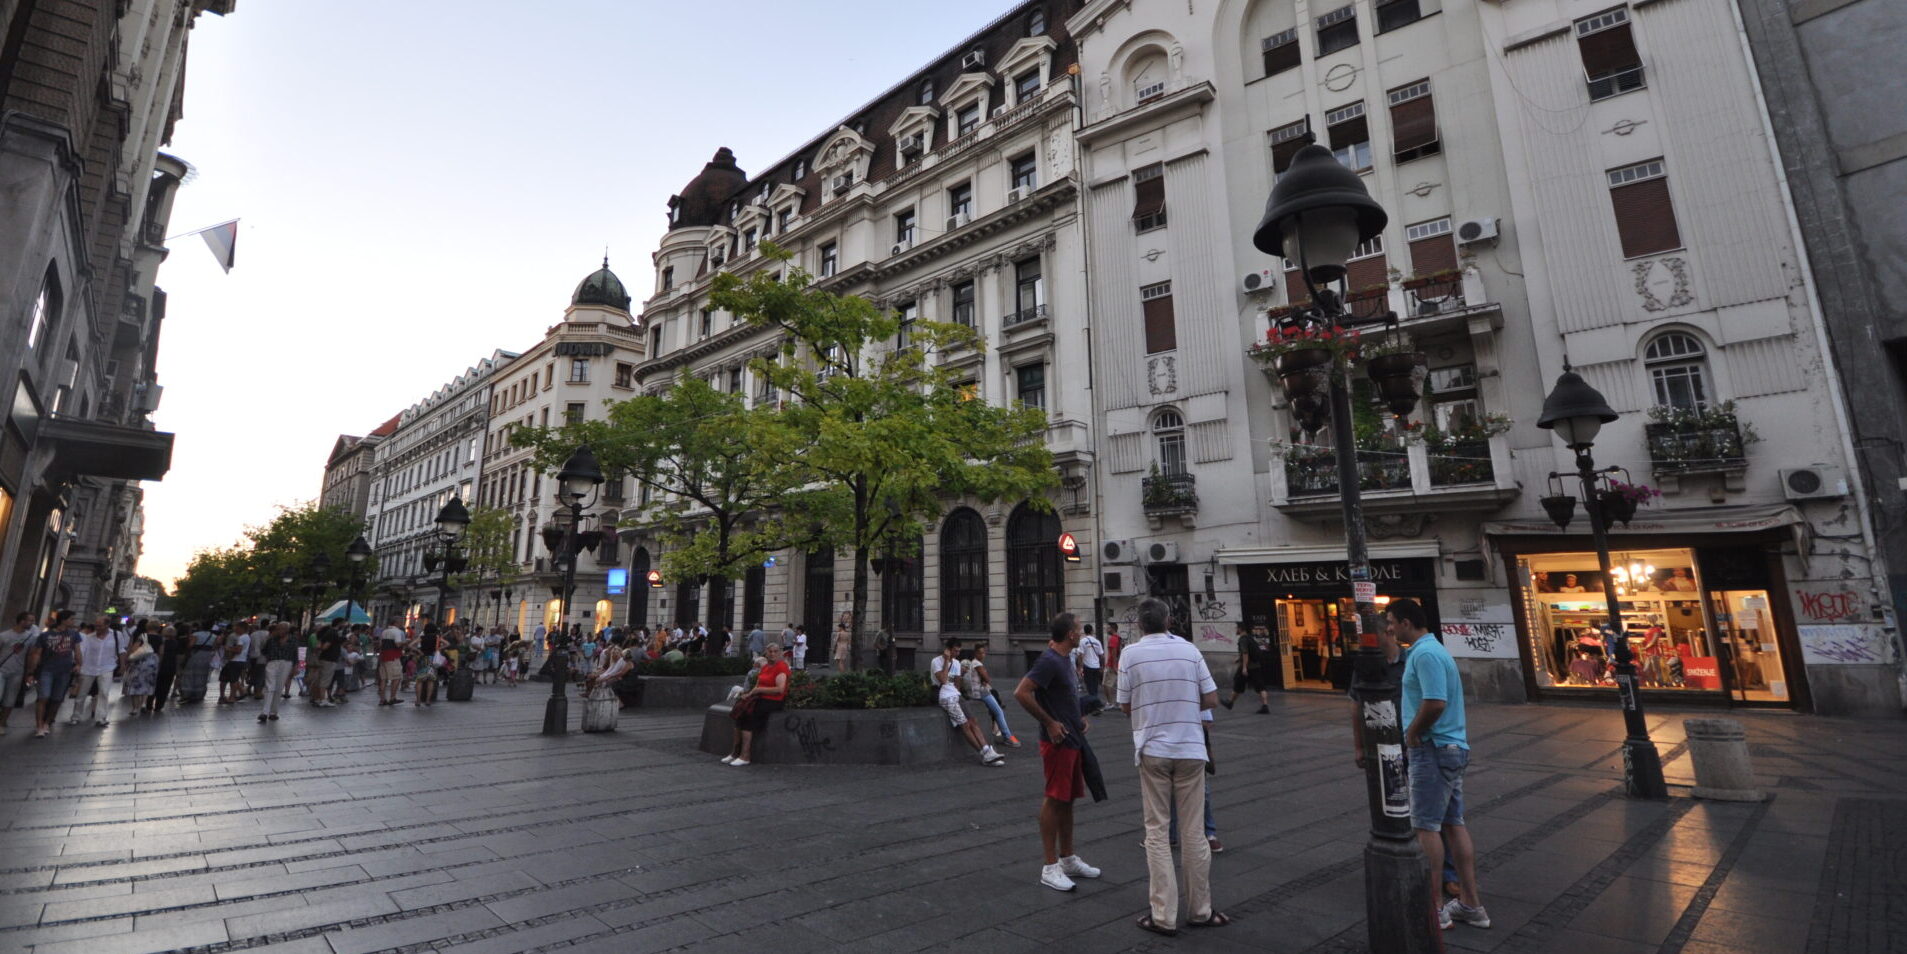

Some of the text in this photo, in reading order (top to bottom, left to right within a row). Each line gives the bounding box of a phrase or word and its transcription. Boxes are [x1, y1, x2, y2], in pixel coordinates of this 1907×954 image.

[1266, 564, 1402, 582] ХЛЕБ & КФЛЕ
